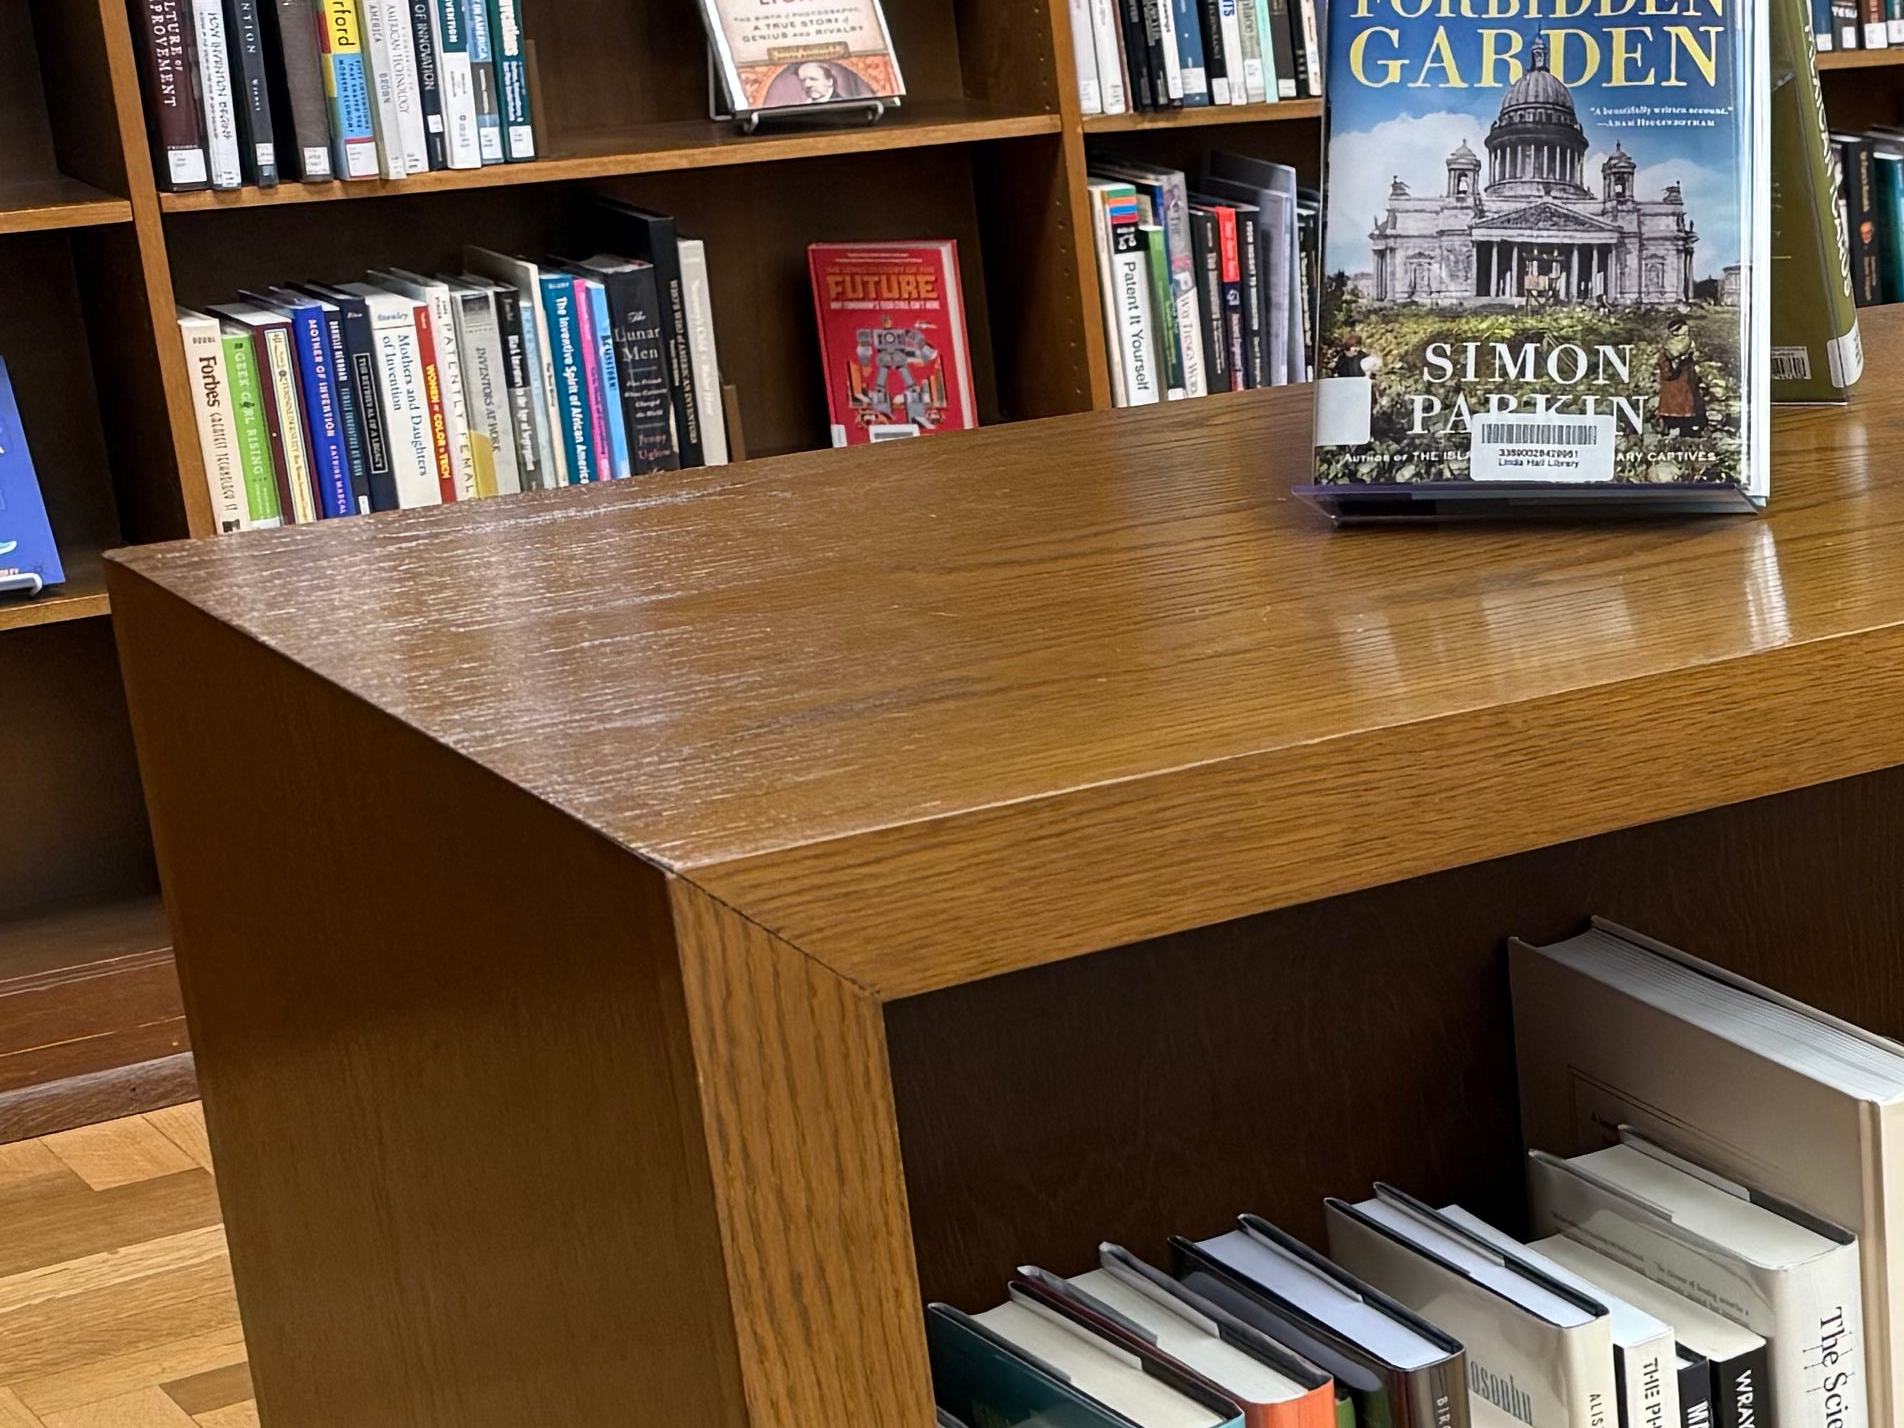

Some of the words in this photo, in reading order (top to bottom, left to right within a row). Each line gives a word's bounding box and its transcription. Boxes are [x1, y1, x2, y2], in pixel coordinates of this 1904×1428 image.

[1348, 24, 1725, 89] GARDEN
[1123, 261, 1139, 310] Patent
[1132, 329, 1149, 390] Yourself
[198, 355, 222, 408] Forbes
[1422, 342, 1635, 385] SIMON
